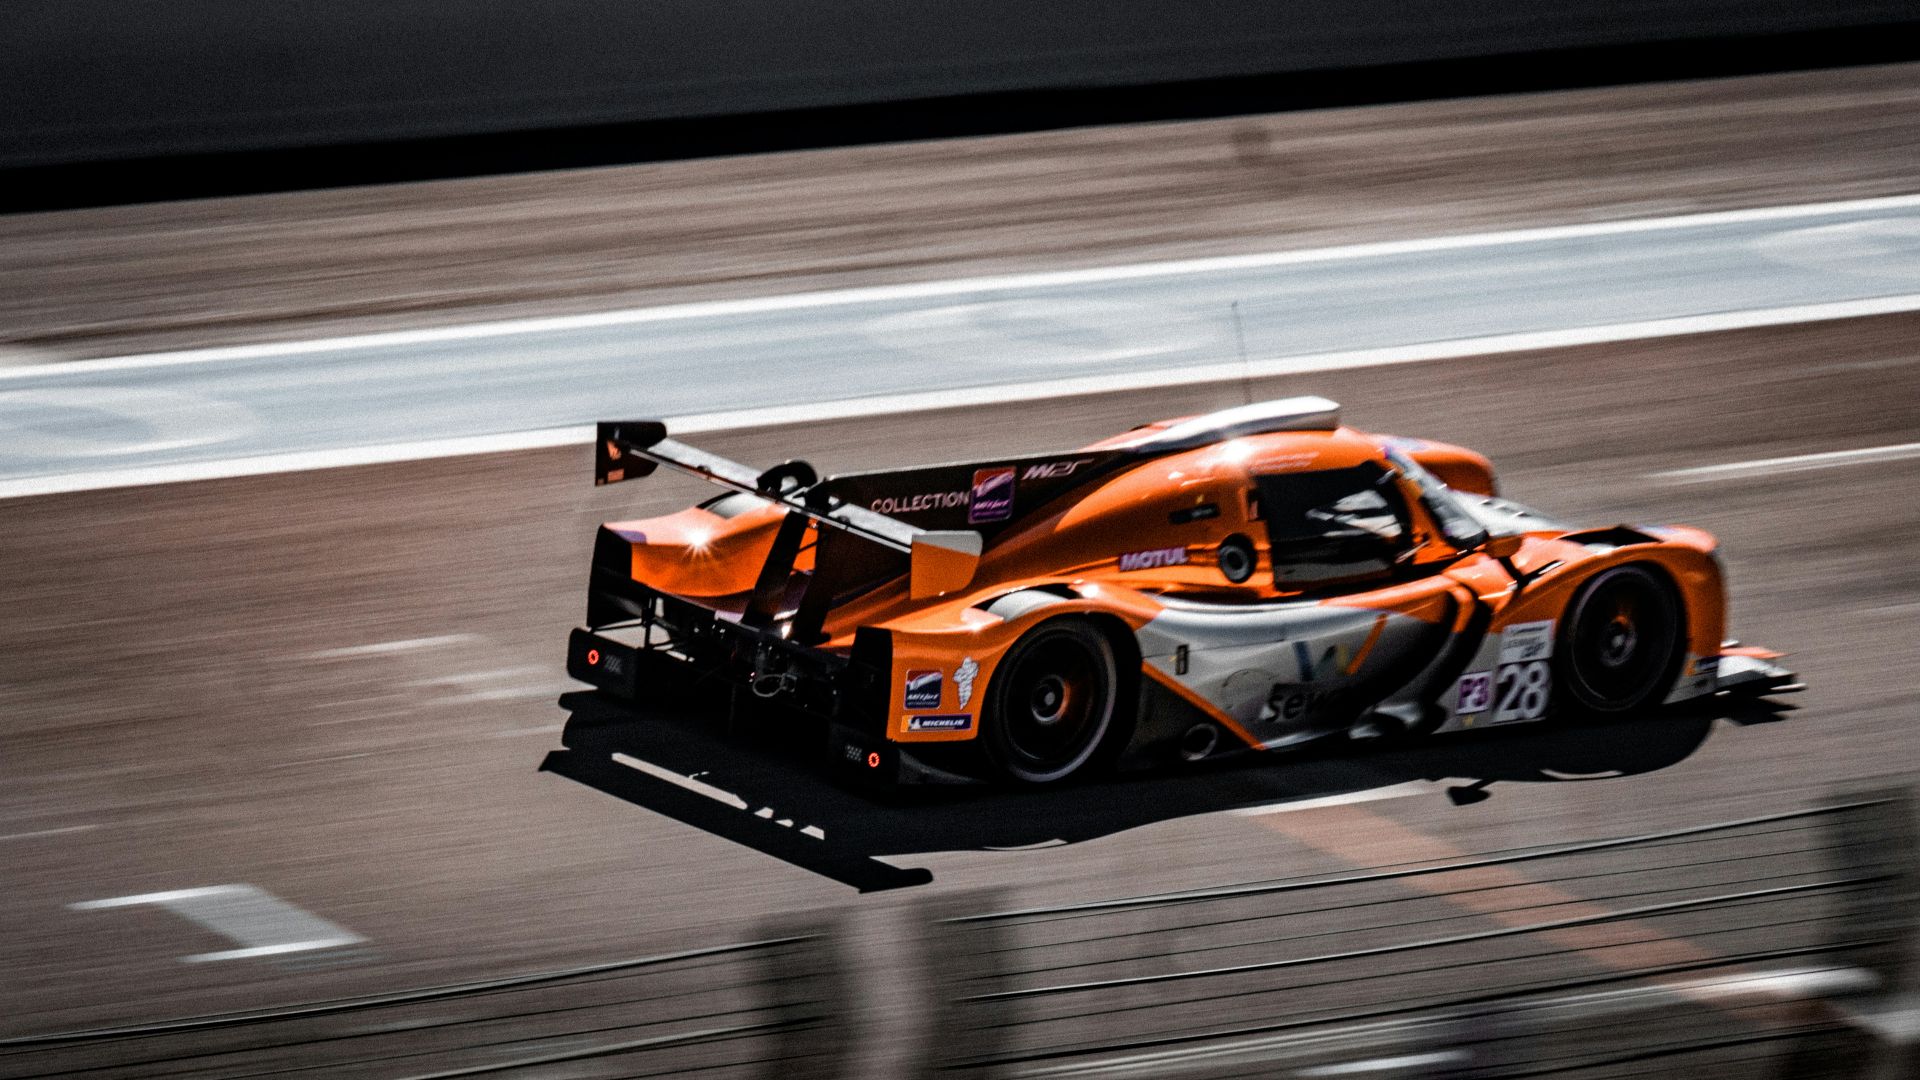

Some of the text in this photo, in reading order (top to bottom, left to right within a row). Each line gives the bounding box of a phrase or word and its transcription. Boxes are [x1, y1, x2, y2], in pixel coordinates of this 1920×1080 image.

[871, 491, 970, 514] COLLECTION
[1120, 547, 1188, 571] MOTUL
[1495, 660, 1549, 720] 28
[921, 719, 965, 727] MICHELIN
